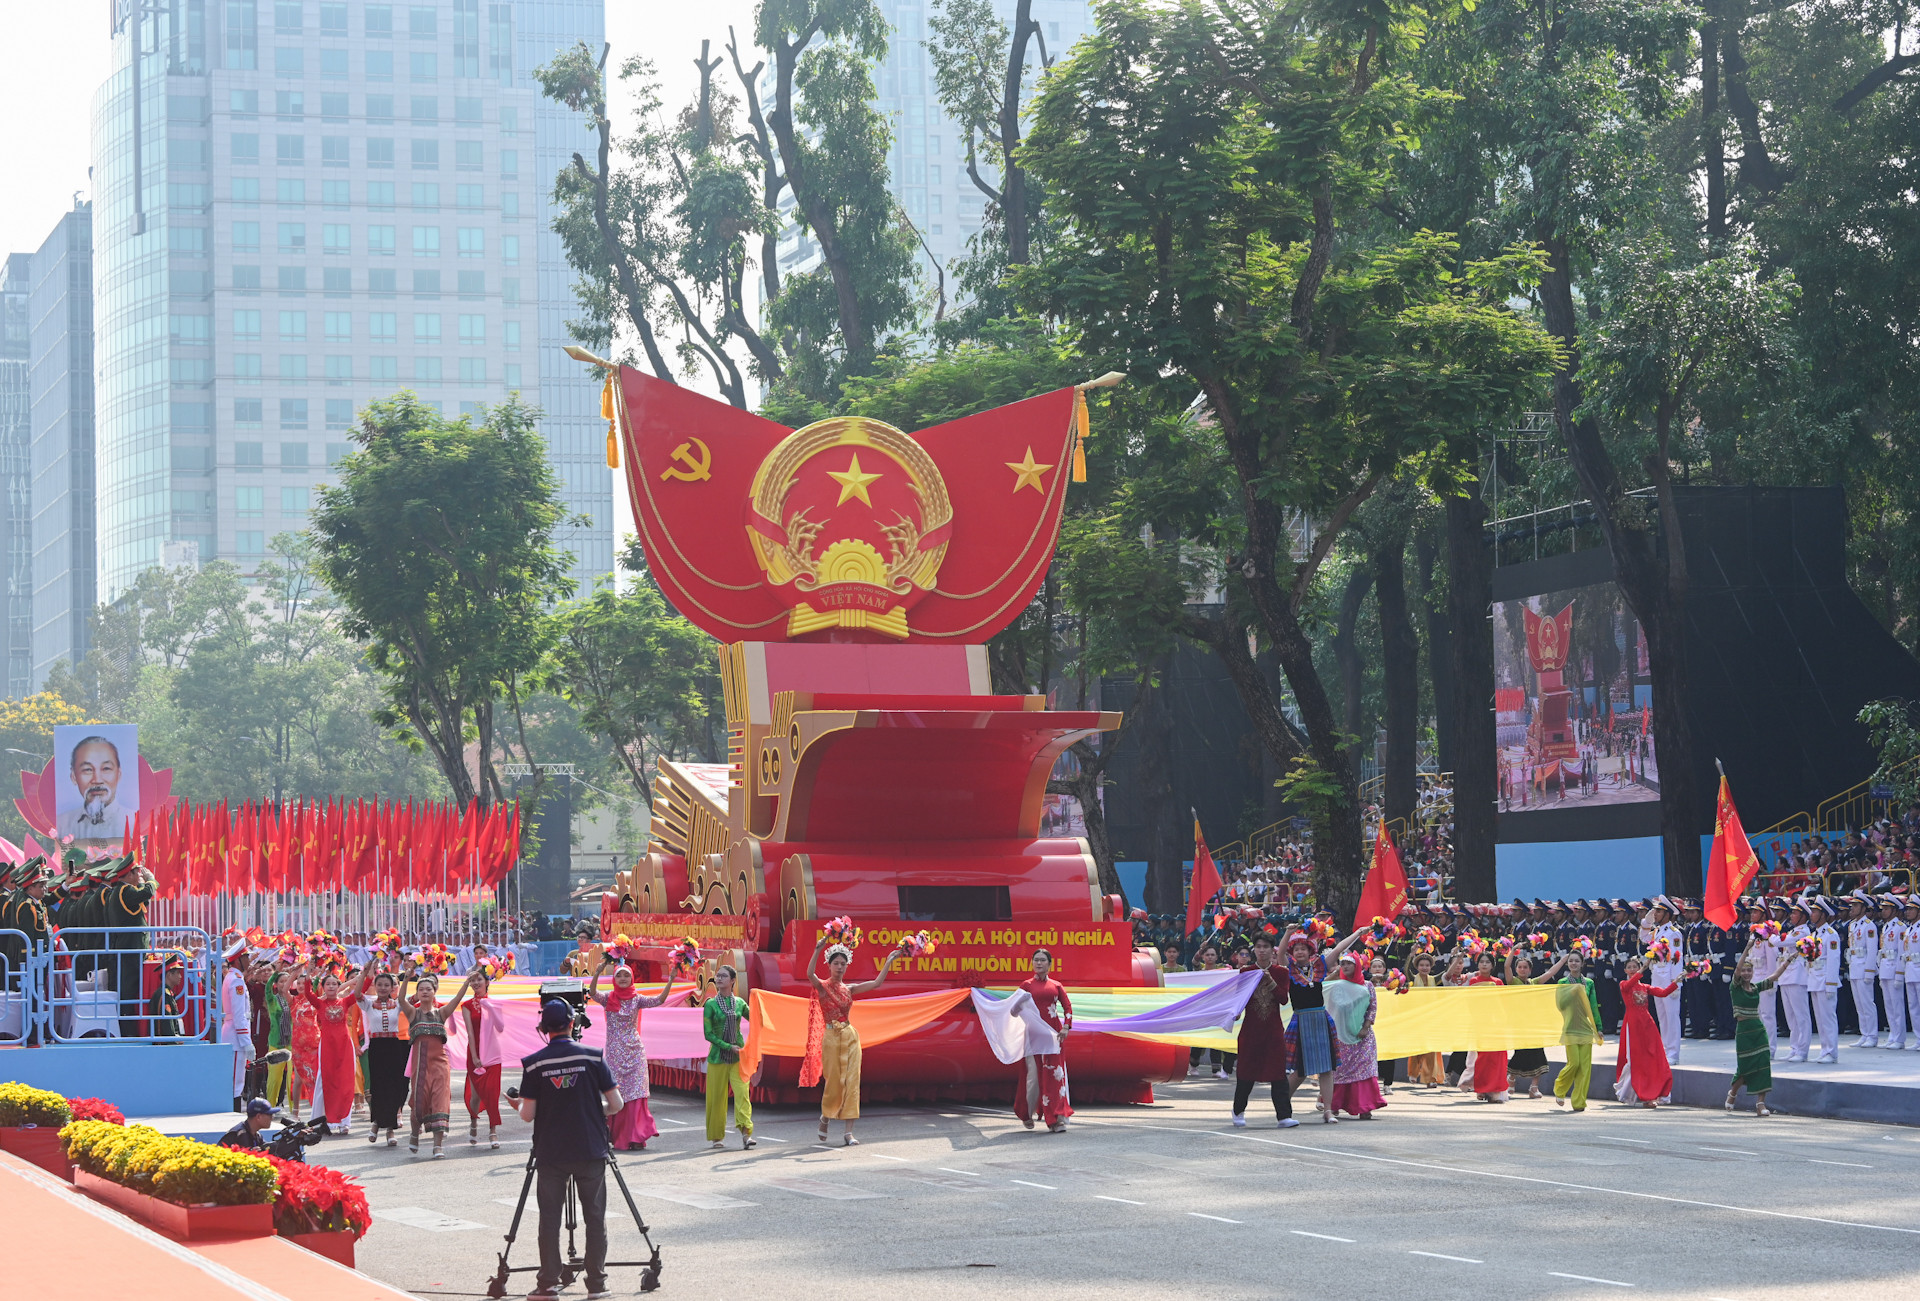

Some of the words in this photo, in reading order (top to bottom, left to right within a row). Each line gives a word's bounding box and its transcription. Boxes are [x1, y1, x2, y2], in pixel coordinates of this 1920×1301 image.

[821, 592, 853, 607] VIỆT
[857, 593, 888, 610] NAM
[920, 927, 955, 945] ÒA
[961, 928, 986, 945] XÃ
[991, 929, 1021, 947] HỘI
[1025, 928, 1059, 945] CHỦ
[1063, 929, 1115, 946] NGHĨA
[917, 957, 957, 972] NAM
[961, 954, 1012, 972] MUÔN
[561, 1066, 586, 1075] TELEVISION
[550, 1073, 578, 1089] VTV
